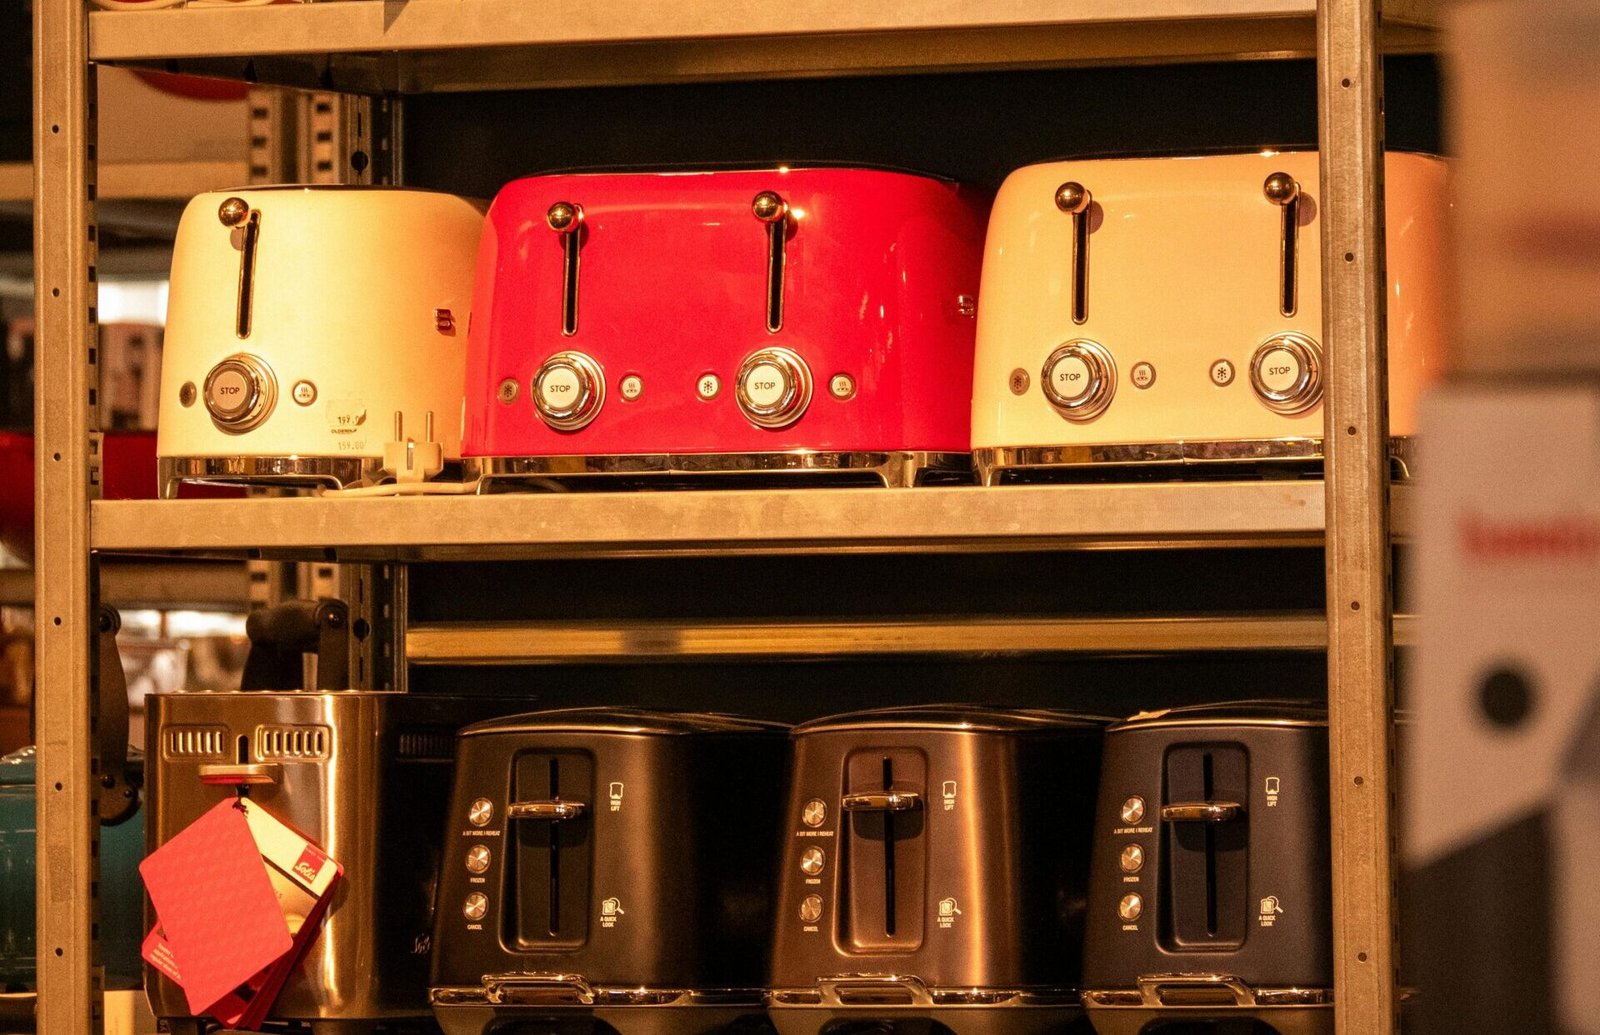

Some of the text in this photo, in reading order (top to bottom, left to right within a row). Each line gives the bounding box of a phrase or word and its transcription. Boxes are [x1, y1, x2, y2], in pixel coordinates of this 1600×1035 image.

[1269, 366, 1291, 375] STOP
[1060, 373, 1081, 381] STOP
[550, 385, 571, 393] STOP
[755, 382, 776, 390] STOP
[220, 387, 240, 395] STOP
[295, 861, 315, 881] Solis
